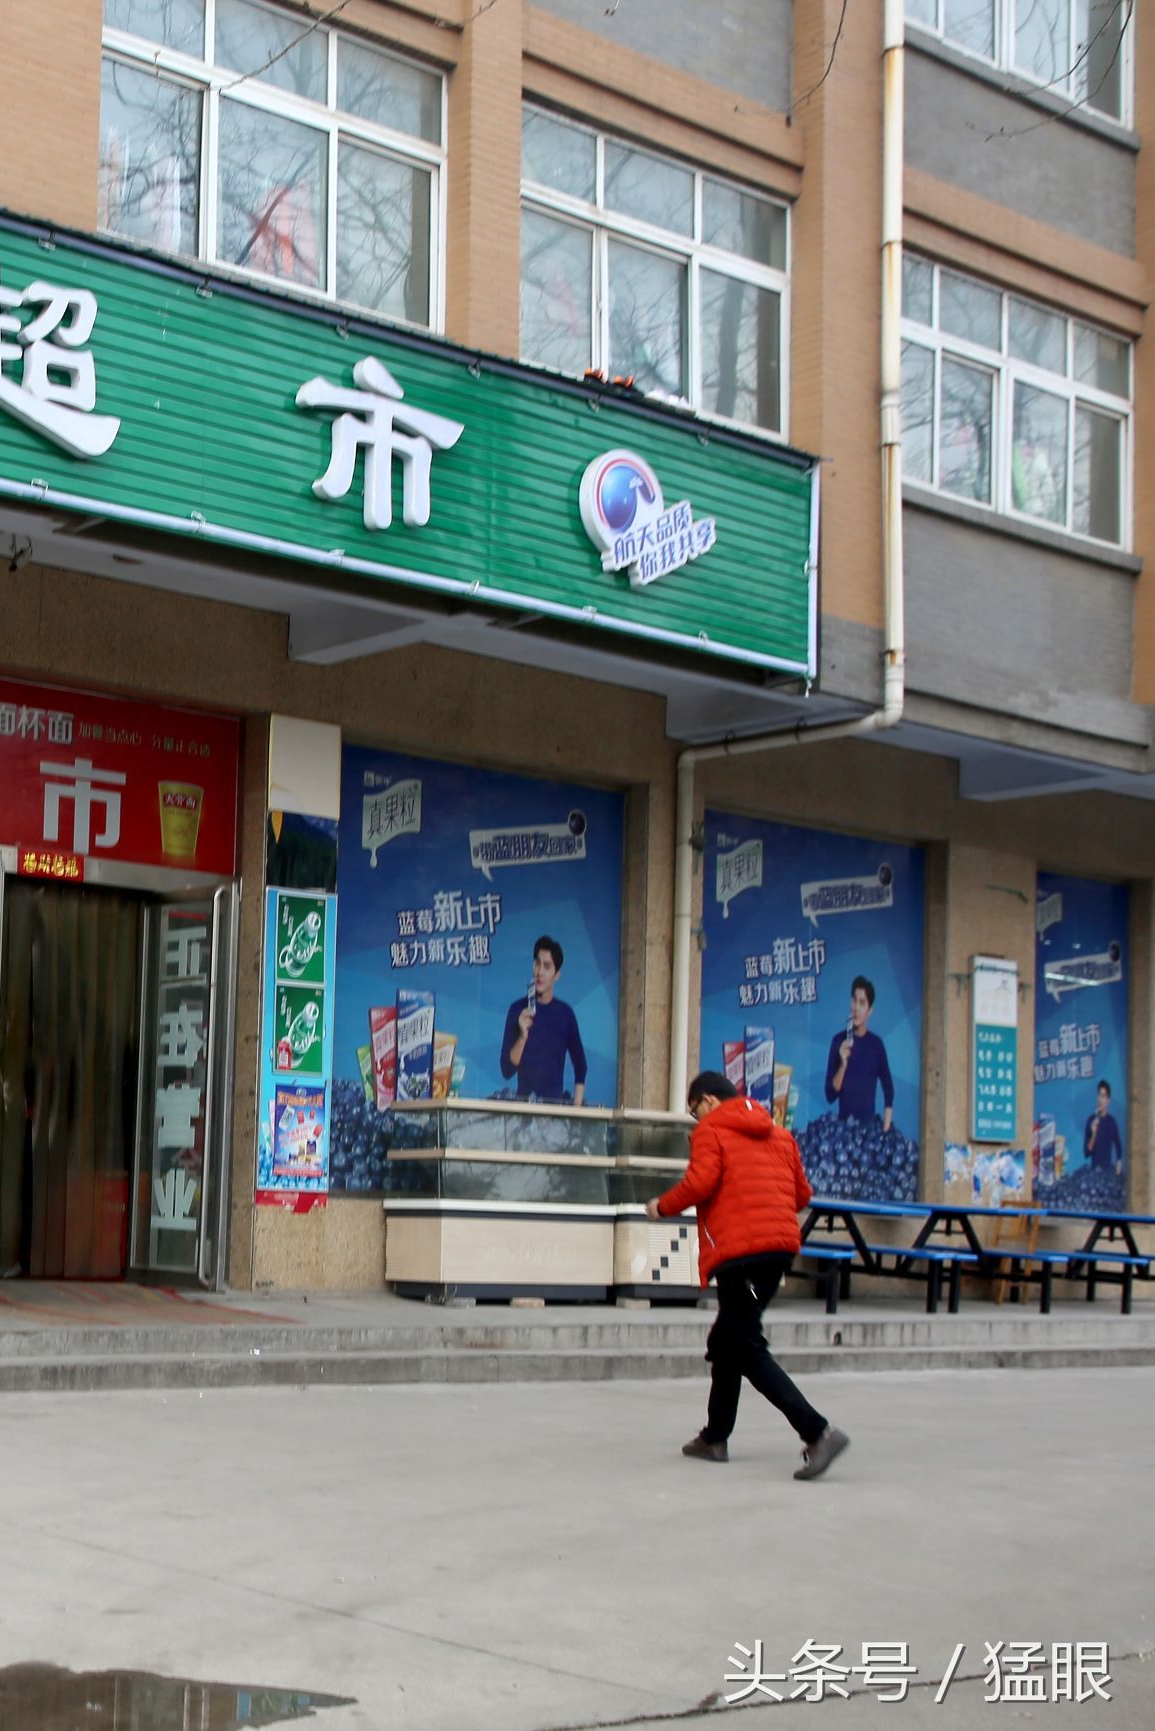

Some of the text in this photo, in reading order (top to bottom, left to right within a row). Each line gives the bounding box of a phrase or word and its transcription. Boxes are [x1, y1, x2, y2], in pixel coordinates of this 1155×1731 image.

[613, 502, 692, 565] 航天品质
[640, 519, 716, 580] 你我共享
[367, 787, 417, 840] 真果粒
[397, 889, 502, 937] 蓝莓新上市
[390, 934, 491, 969] 魅力新乐趣
[744, 937, 826, 979] 蓝莓新上市
[739, 976, 818, 1008] 魅力新乐趣
